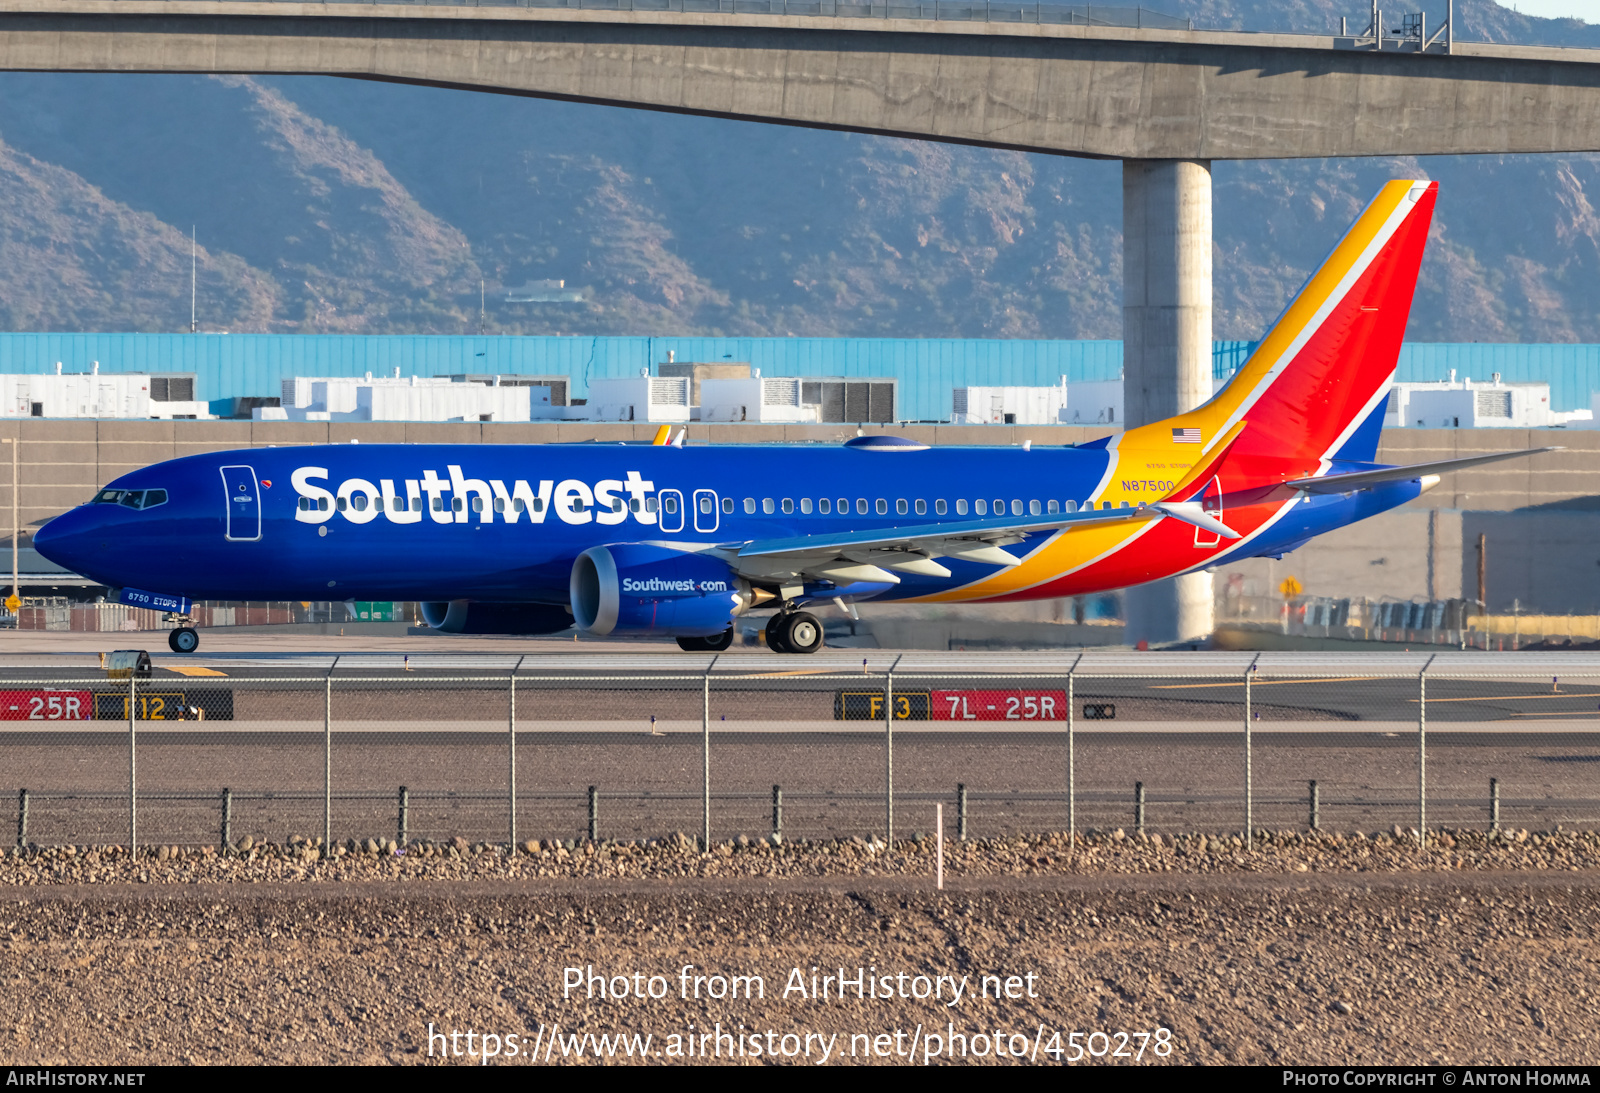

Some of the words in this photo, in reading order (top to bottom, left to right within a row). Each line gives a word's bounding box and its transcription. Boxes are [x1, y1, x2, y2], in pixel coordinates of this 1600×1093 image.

[290, 465, 658, 525] Southwest
[1121, 480, 1174, 492] N87500
[128, 592, 150, 603] 8750
[153, 597, 178, 608] ETOPS
[29, 697, 81, 719] 25R
[945, 696, 977, 719] 7L
[1006, 696, 1056, 719] 25R
